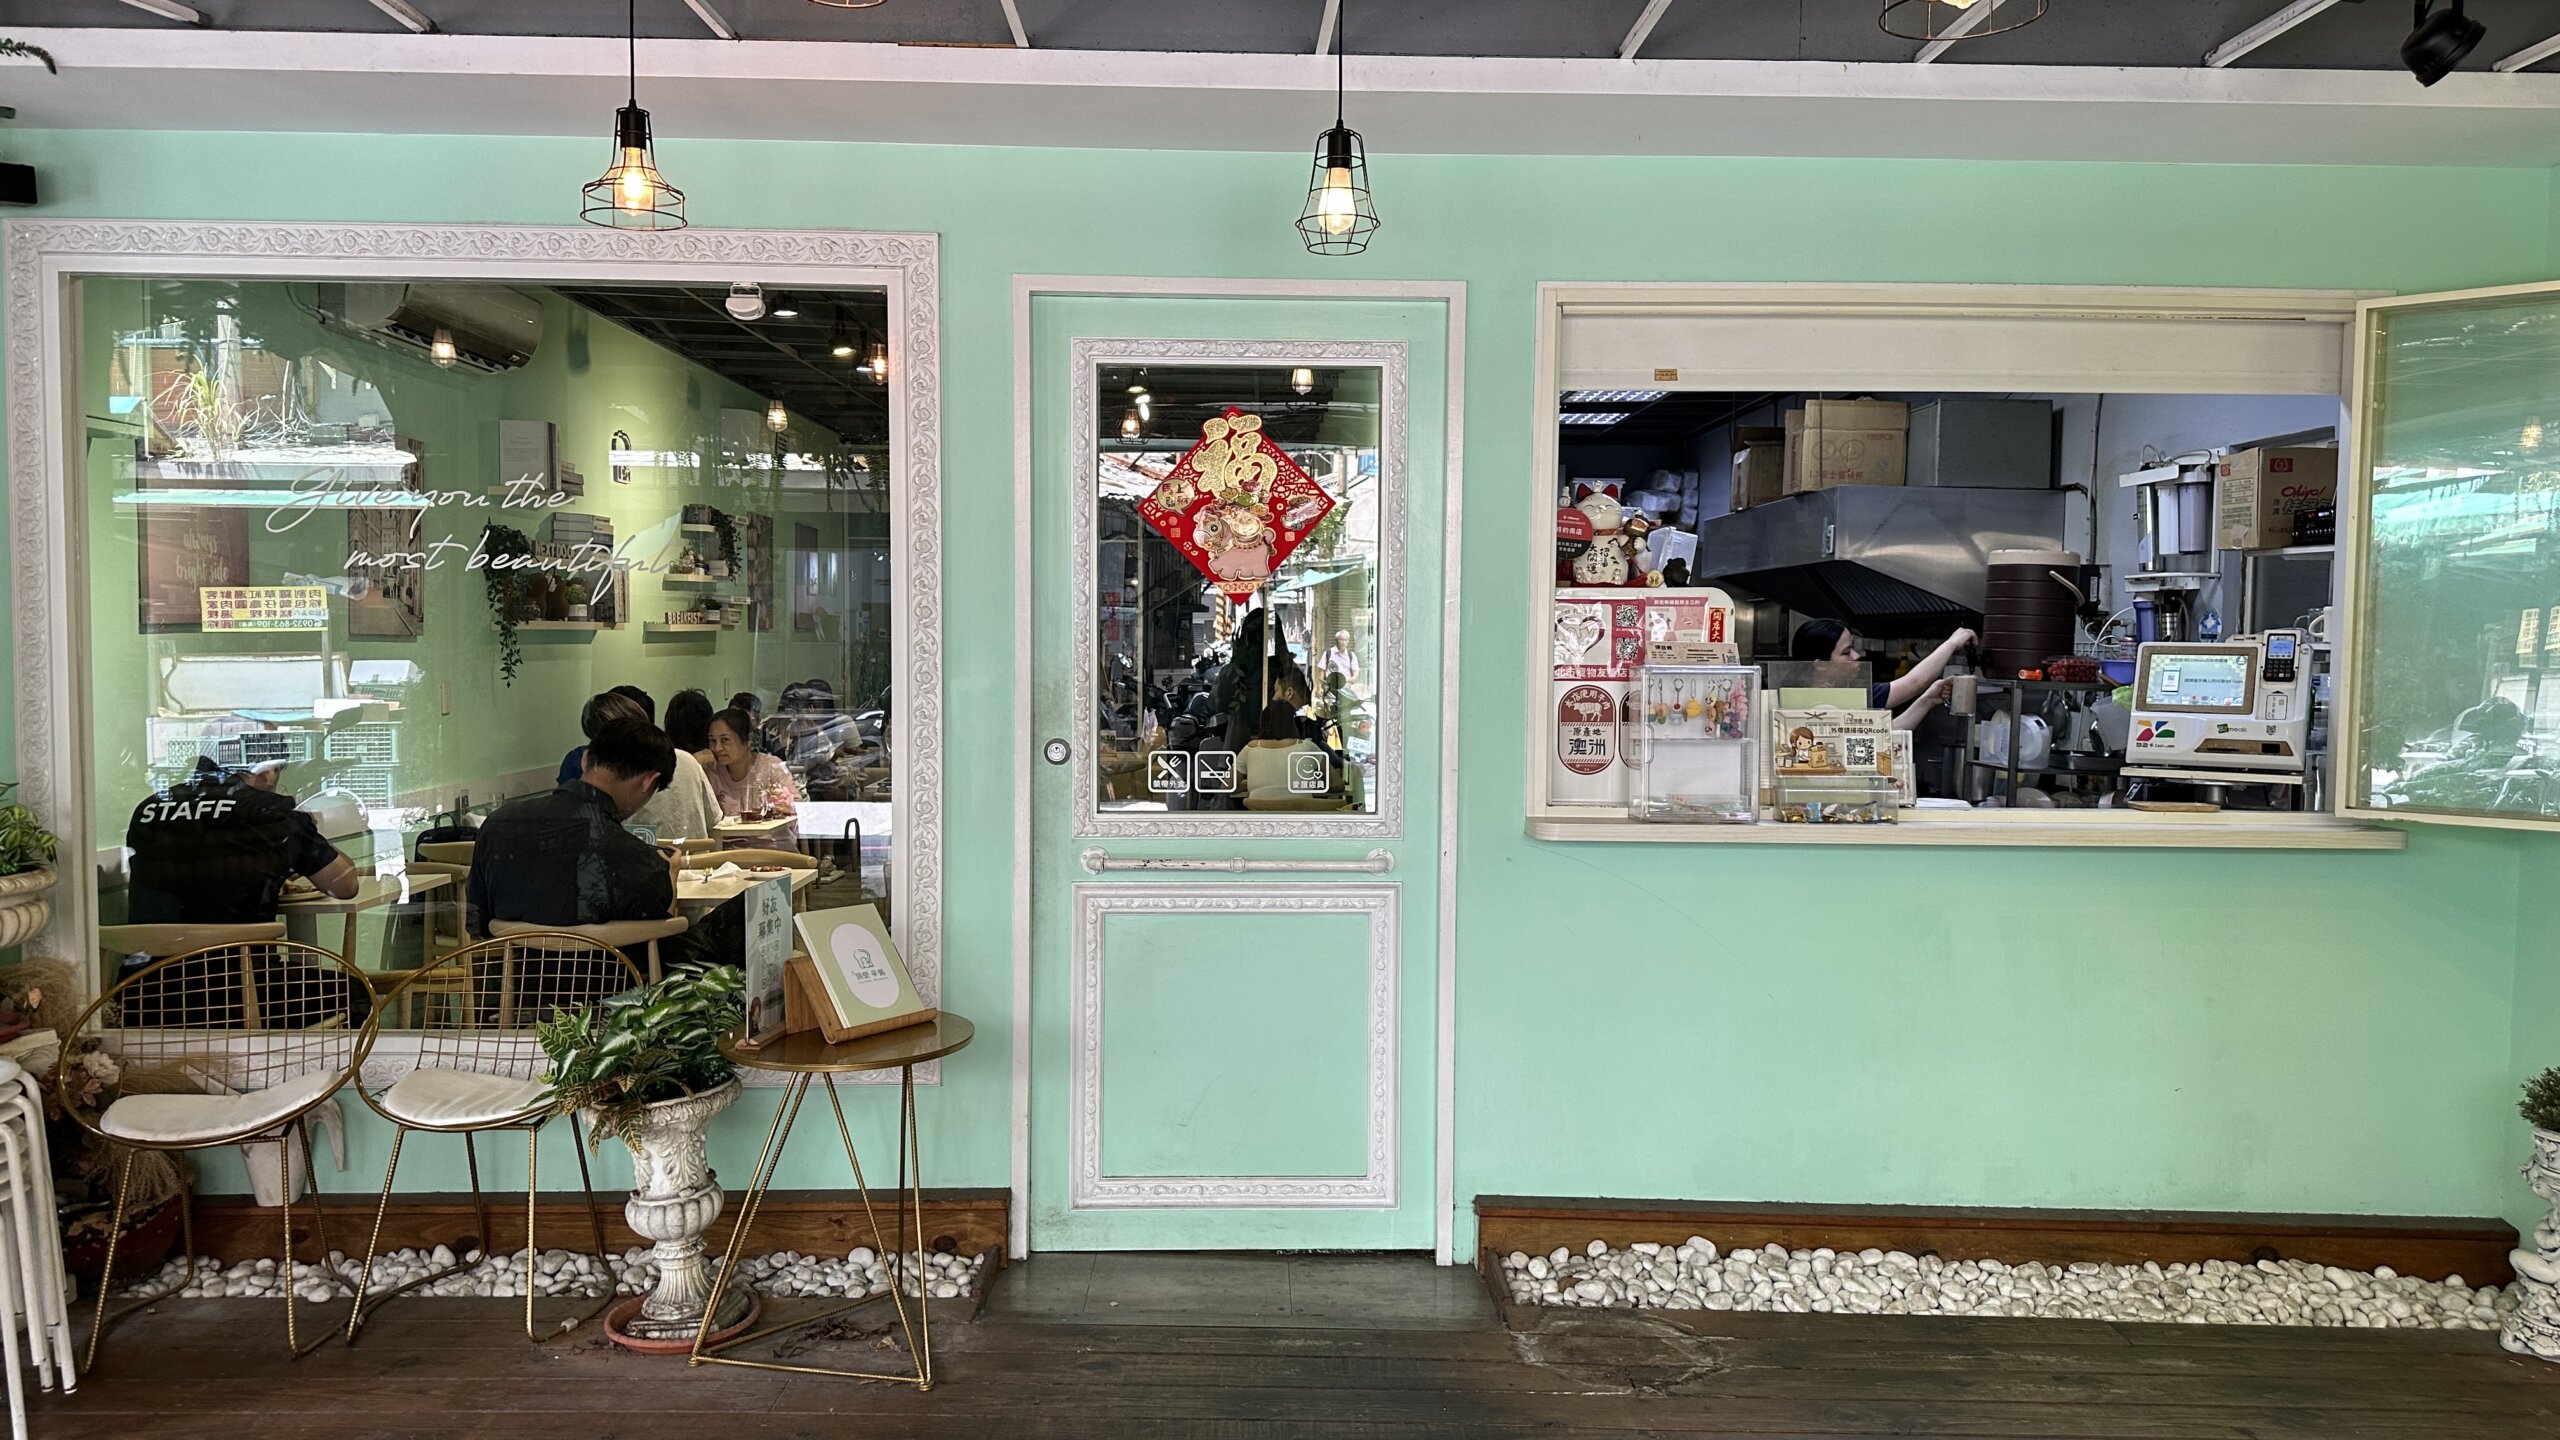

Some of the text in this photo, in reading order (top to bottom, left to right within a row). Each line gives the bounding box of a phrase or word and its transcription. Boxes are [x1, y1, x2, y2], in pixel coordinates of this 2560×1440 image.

[1192, 415, 1277, 499] 福
[265, 466, 576, 539] Give you the
[183, 528, 218, 557] always
[556, 542, 575, 558] DOO
[343, 516, 680, 606] most beautiful
[1587, 544, 1597, 574] 大開運
[175, 554, 229, 592] bright side
[667, 612, 702, 624] BREAKFAST
[1711, 610, 1722, 642] 開店大
[1573, 727, 1602, 736] 原產地
[1568, 738, 1606, 756] 澳洲
[1292, 780, 1325, 789] 愛護店員
[140, 799, 237, 823] STAFF
[762, 895, 778, 917] 好友
[757, 916, 782, 941] 募集中
